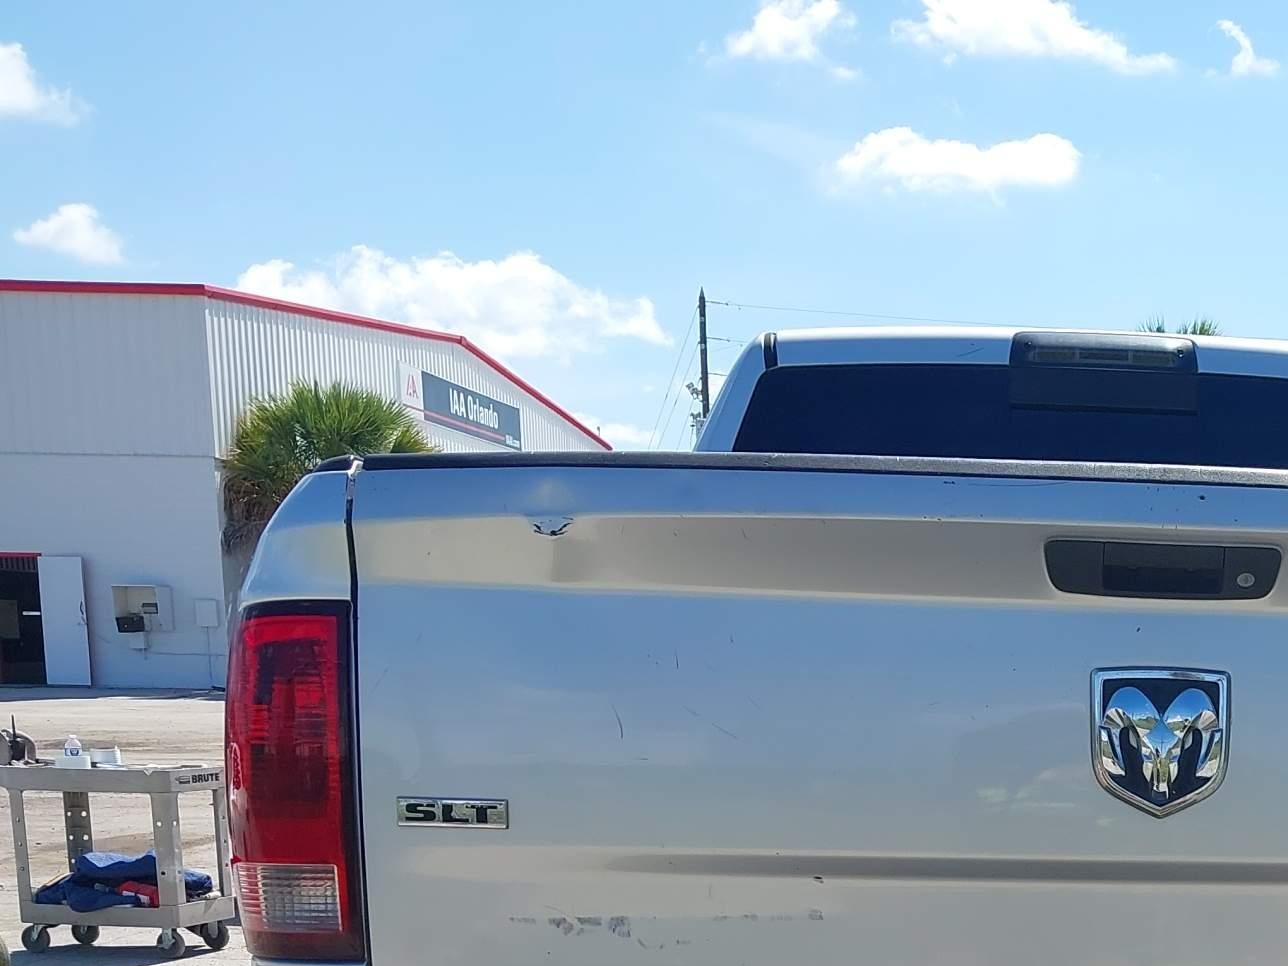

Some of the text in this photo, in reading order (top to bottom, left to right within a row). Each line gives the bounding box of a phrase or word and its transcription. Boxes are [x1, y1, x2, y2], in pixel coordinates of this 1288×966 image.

[449, 388, 499, 430] IAA Orlando
[191, 773, 220, 784] BRUTE
[404, 802, 498, 825] SLT
